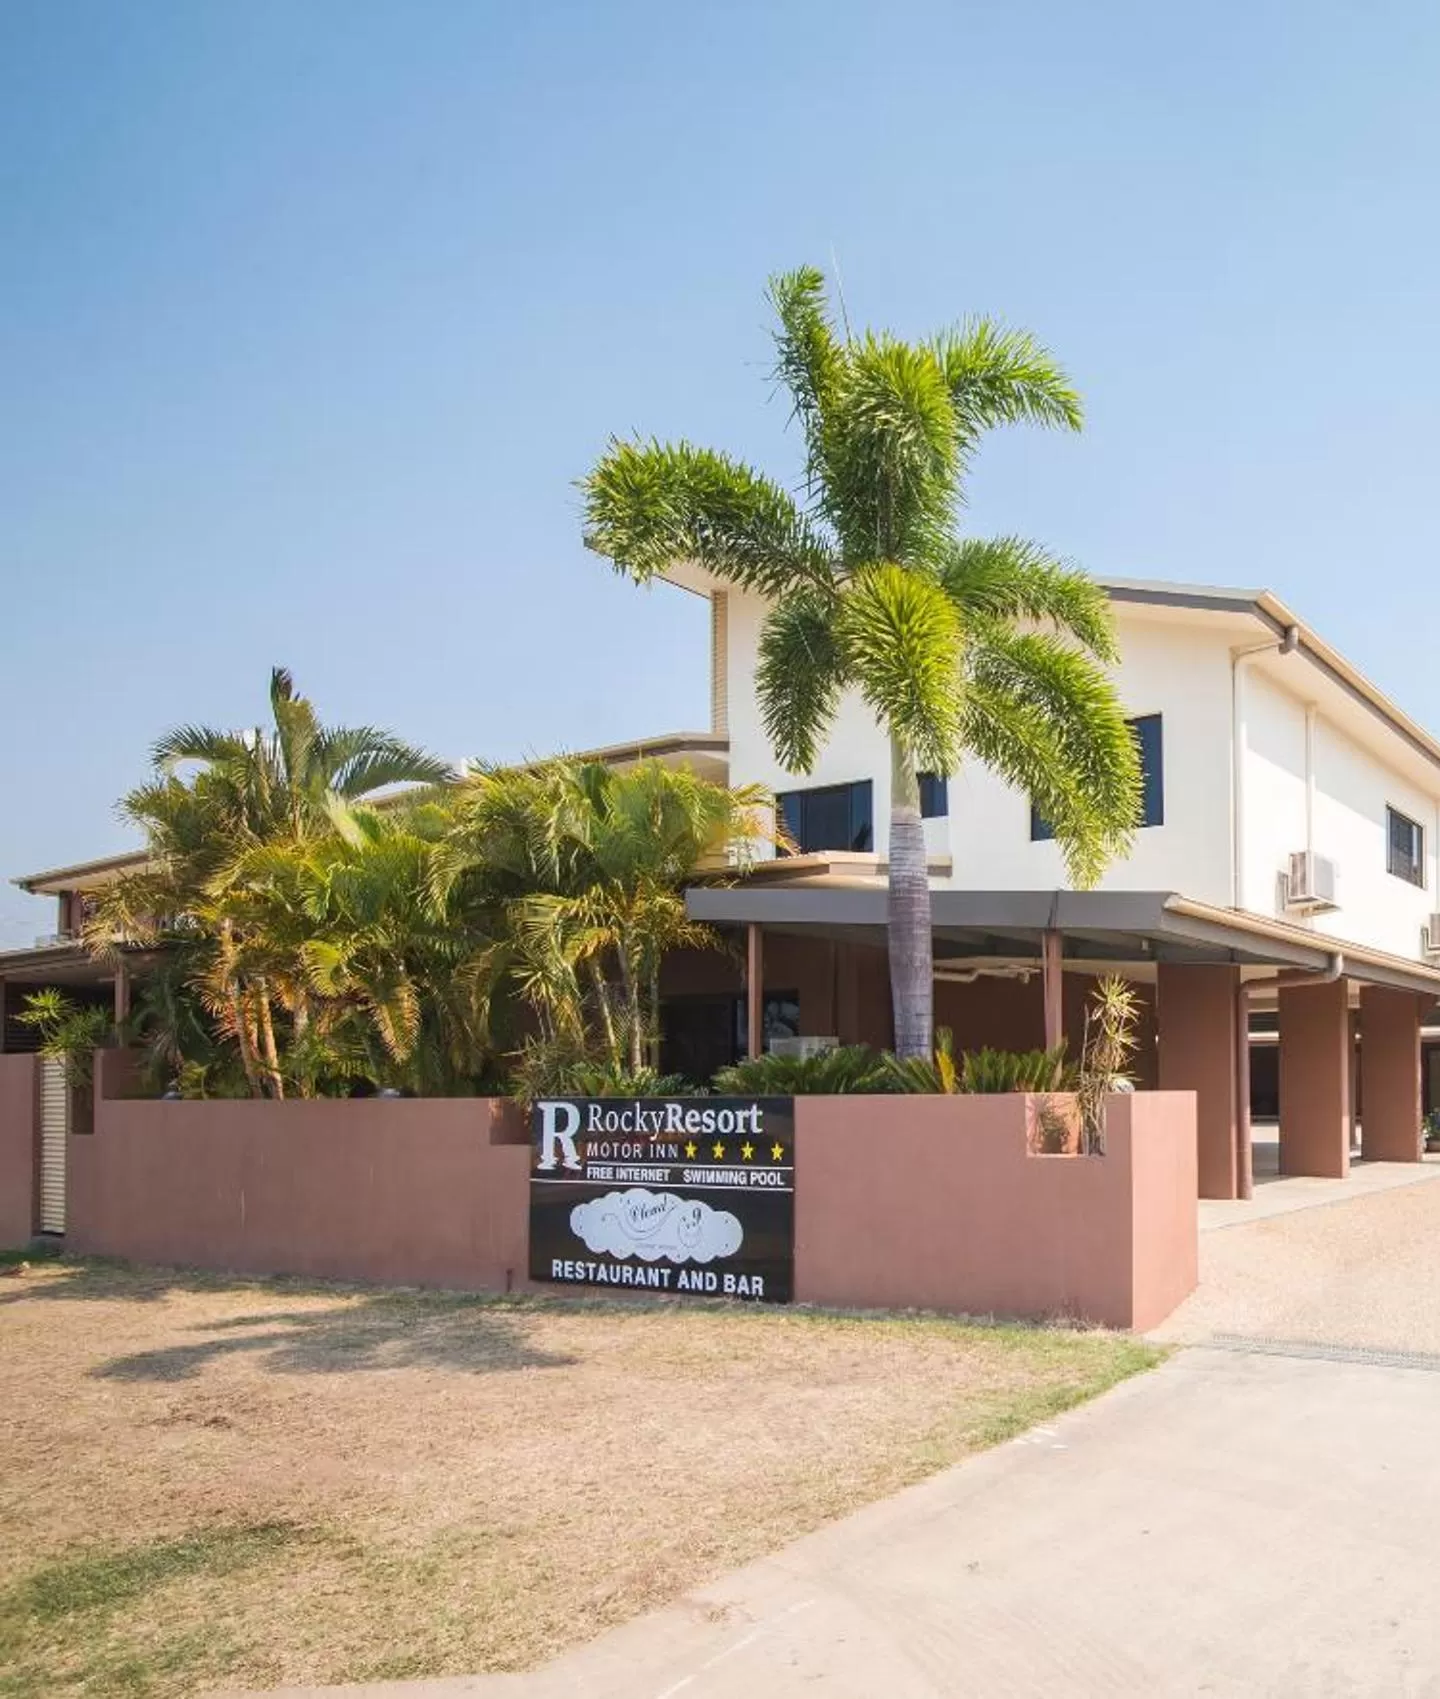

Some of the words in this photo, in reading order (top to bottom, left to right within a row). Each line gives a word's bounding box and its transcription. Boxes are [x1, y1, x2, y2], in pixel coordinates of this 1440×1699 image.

[537, 1101, 582, 1170] R
[586, 1144, 643, 1158] MOTOR
[650, 1144, 679, 1159] INN
[586, 1166, 614, 1180] FREE
[615, 1168, 671, 1182] INTERNET
[682, 1169, 747, 1185] SWIMMING
[750, 1172, 784, 1186] POOL
[552, 1259, 672, 1285] RESTAURANT
[677, 1270, 718, 1292] AND
[723, 1275, 764, 1297] BAR
